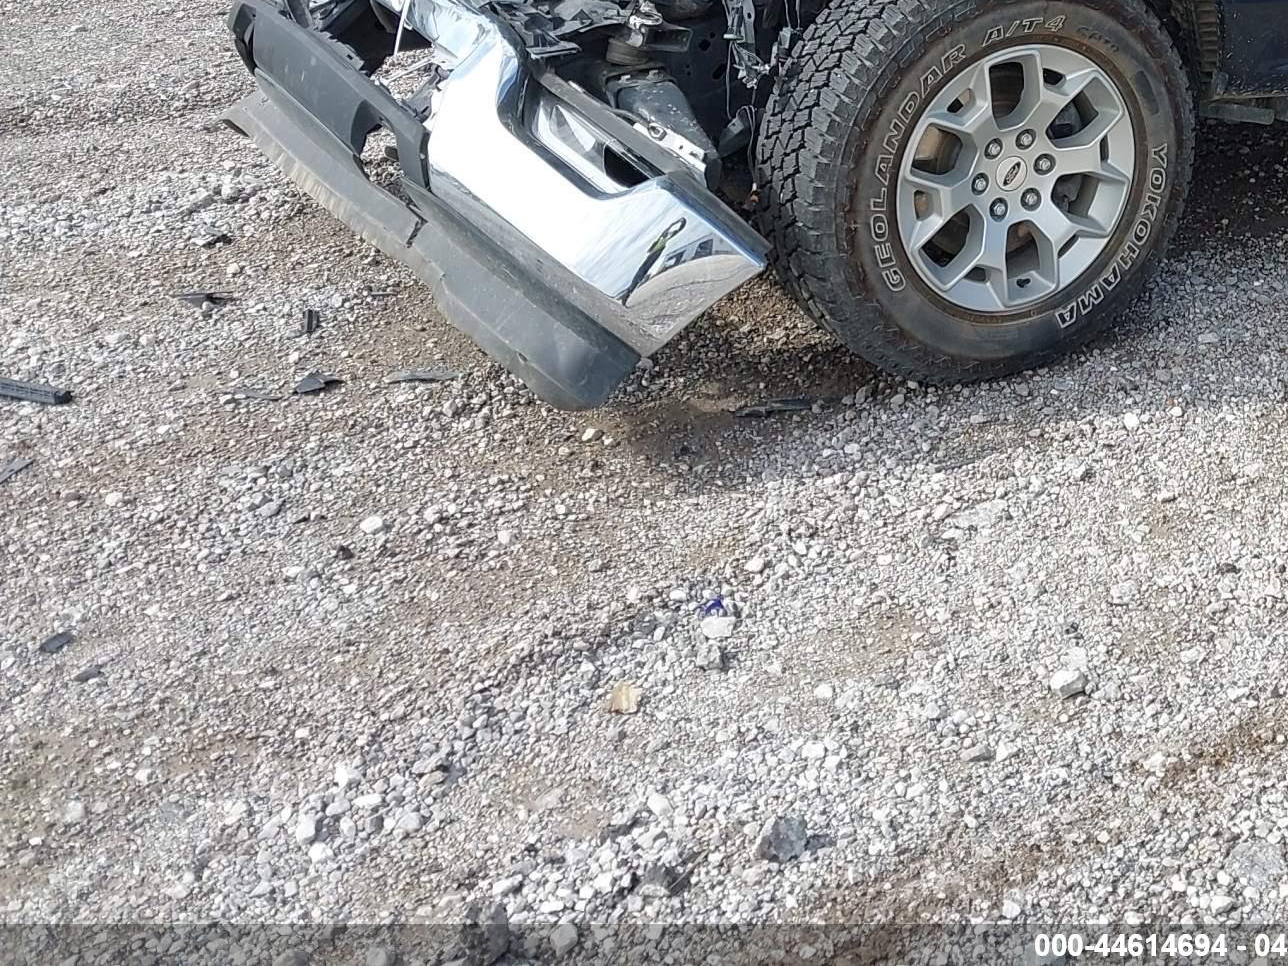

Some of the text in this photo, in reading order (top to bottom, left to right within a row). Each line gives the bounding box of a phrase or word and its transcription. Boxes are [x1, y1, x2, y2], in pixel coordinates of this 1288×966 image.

[870, 14, 1067, 292] GEOLANDAR A/T4
[1055, 143, 1168, 329] YOKOHAMA
